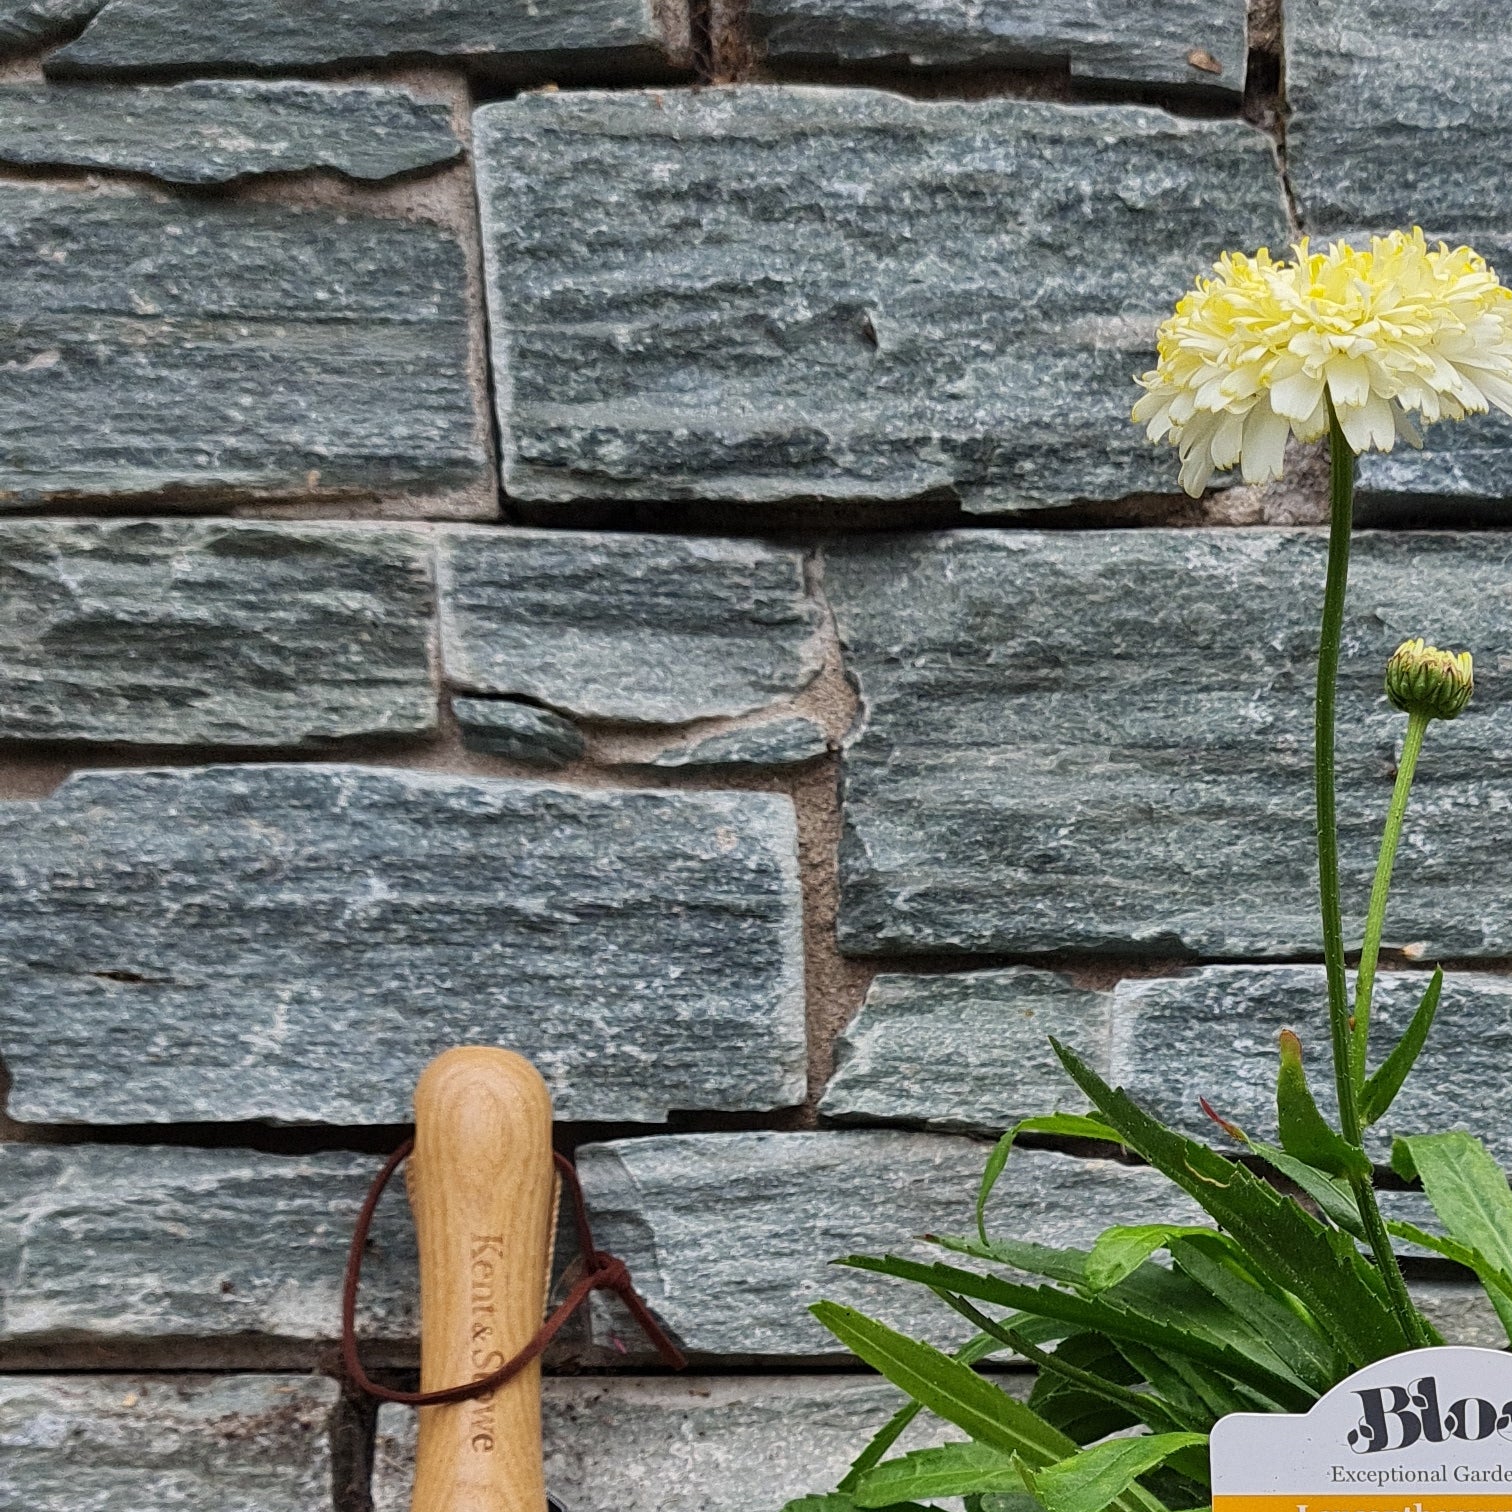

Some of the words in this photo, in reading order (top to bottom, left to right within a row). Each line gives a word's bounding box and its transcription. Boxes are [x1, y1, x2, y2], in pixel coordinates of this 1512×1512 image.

[472, 1234, 503, 1314] Kent
[472, 1322, 493, 1341] &
[1331, 1465, 1447, 1487] Exceptional
